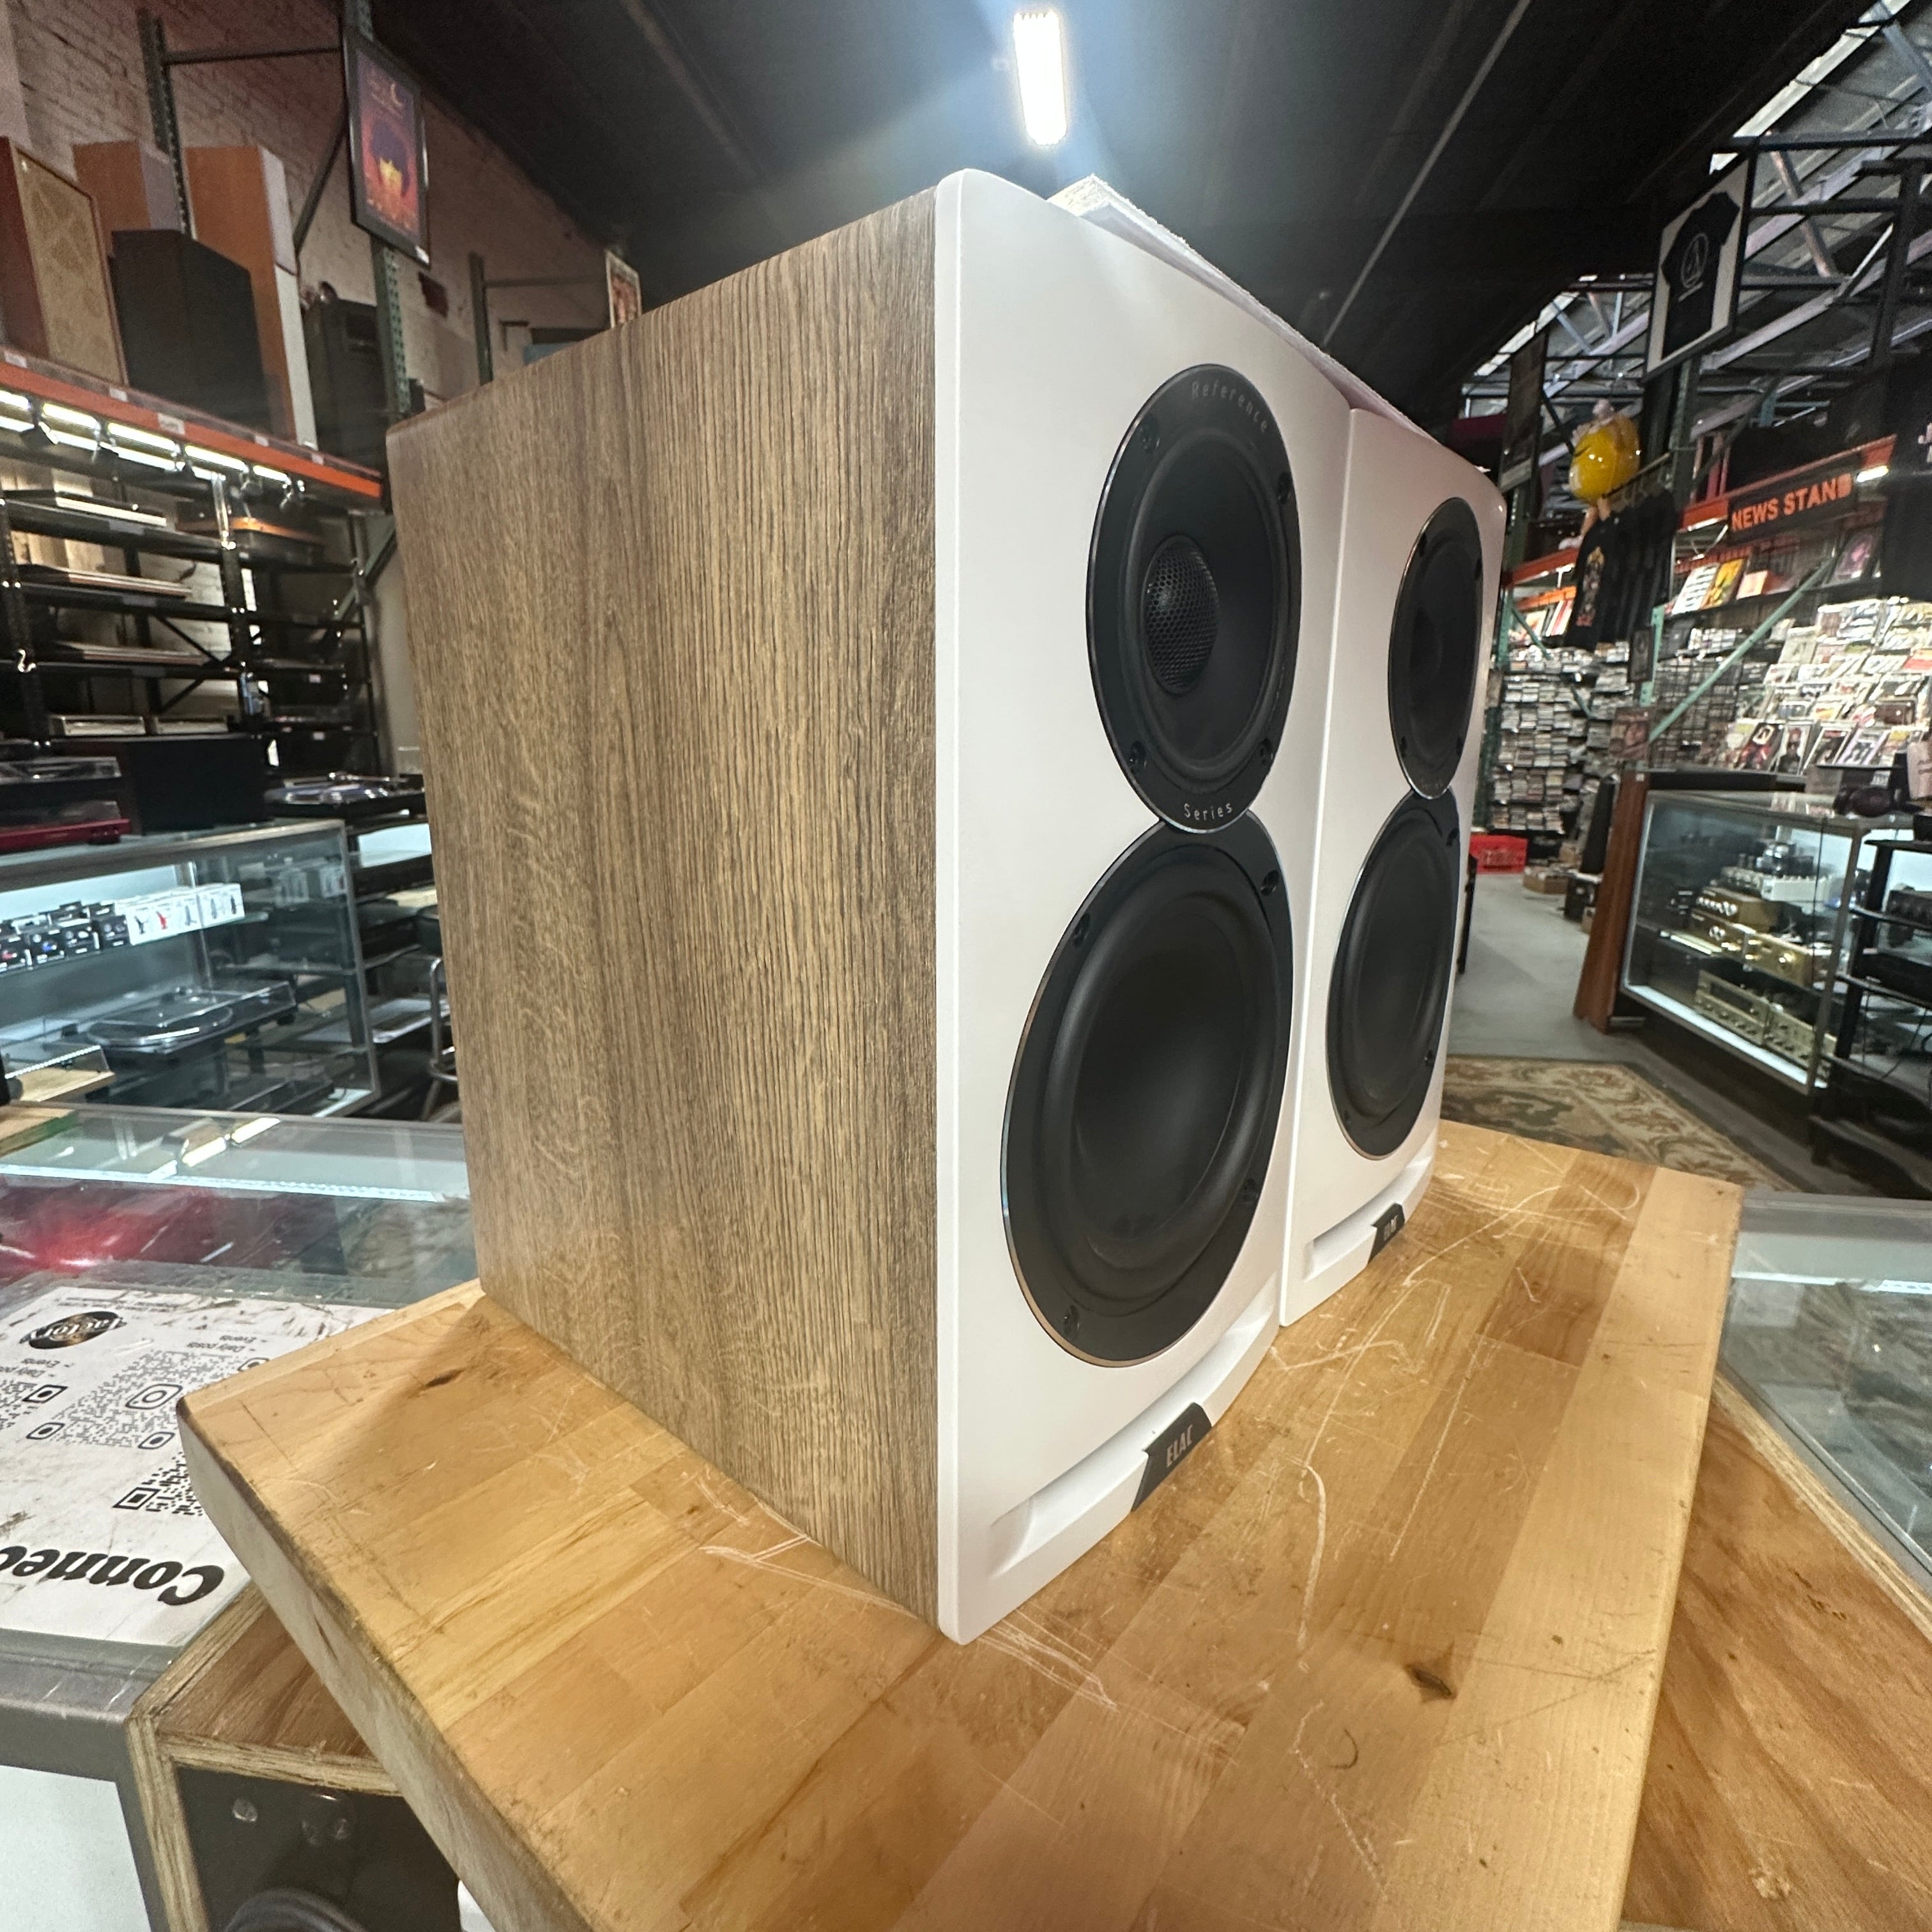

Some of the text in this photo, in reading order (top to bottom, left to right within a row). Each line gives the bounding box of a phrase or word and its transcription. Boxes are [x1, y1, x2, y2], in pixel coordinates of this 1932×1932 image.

[1192, 379, 1268, 433] Reference
[1732, 473, 1852, 530] NEWS STAND
[1184, 802, 1232, 821] Series
[1167, 1423, 1193, 1468] ELAC
[0, 1545, 224, 1606] Connec
